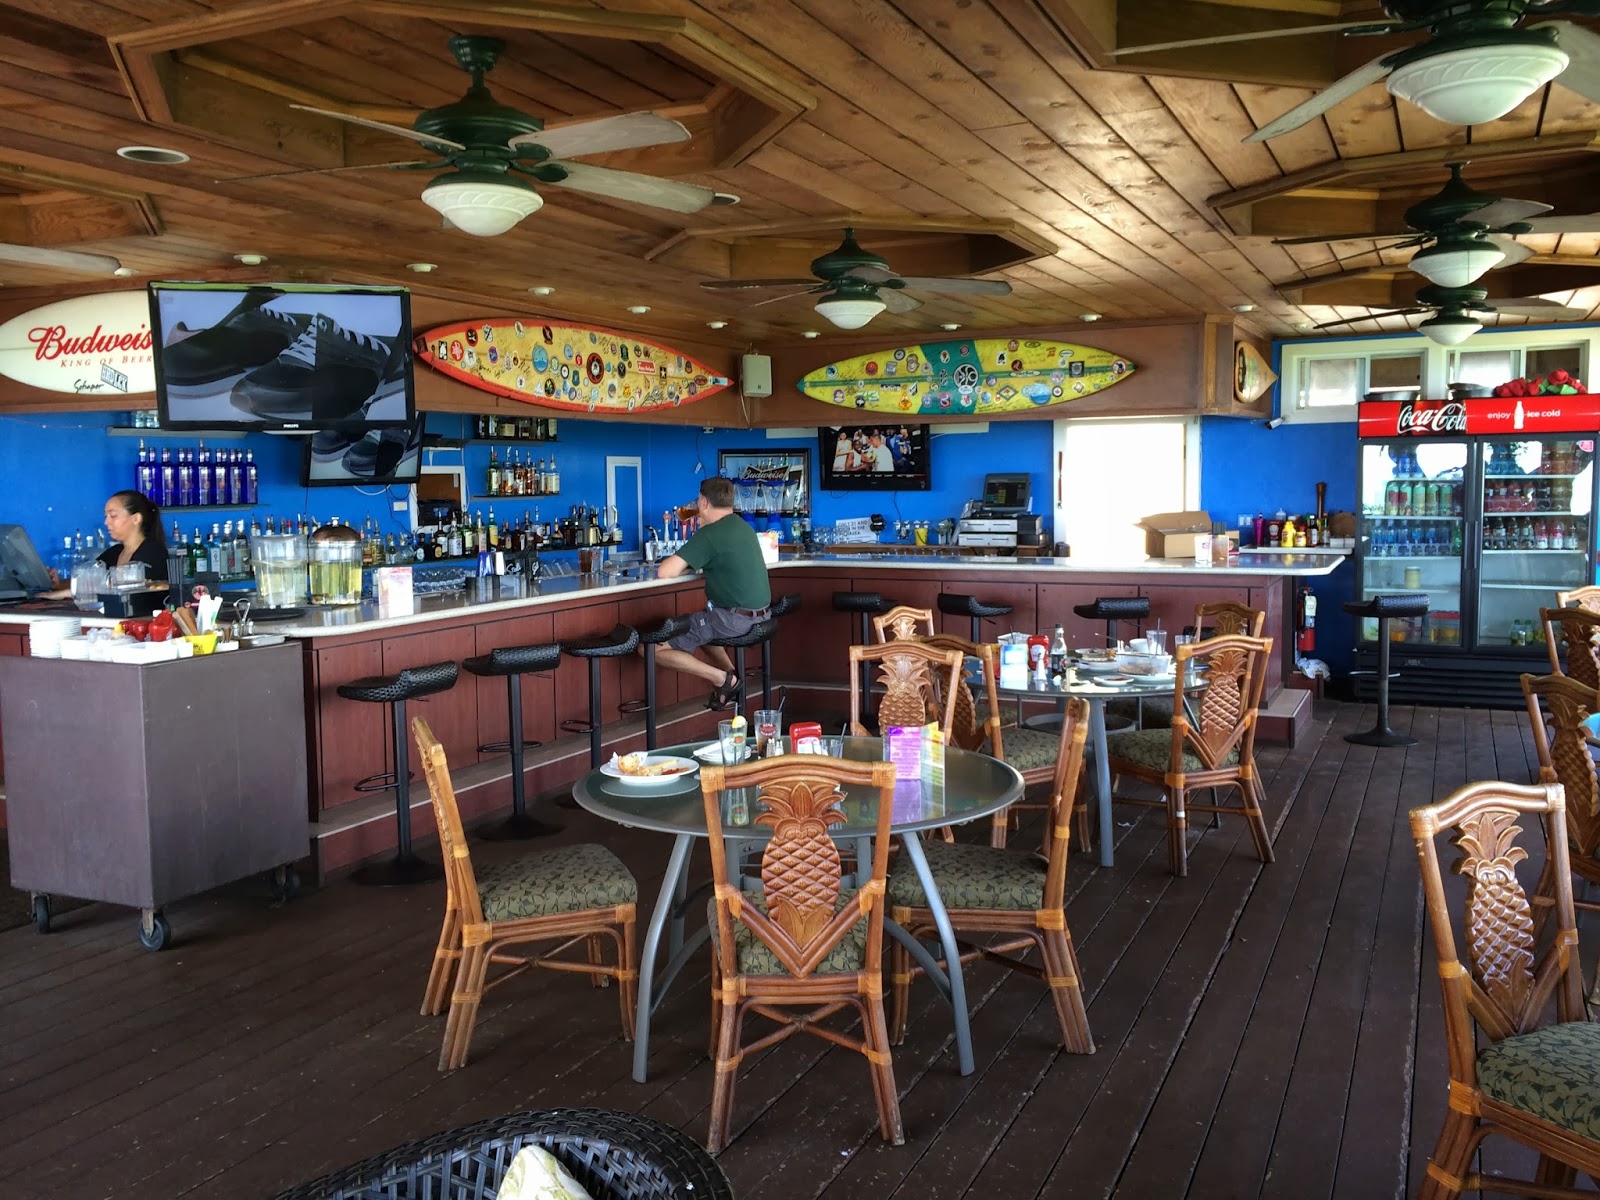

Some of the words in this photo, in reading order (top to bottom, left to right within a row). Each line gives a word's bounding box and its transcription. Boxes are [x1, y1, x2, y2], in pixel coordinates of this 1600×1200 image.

[28, 323, 153, 361] Budweis
[60, 359, 91, 368] KING
[100, 357, 115, 365] OF
[1397, 403, 1468, 434] Coca-Cola
[1487, 411, 1512, 420] enjoy
[1527, 410, 1539, 418] ice
[1541, 409, 1561, 418] cold
